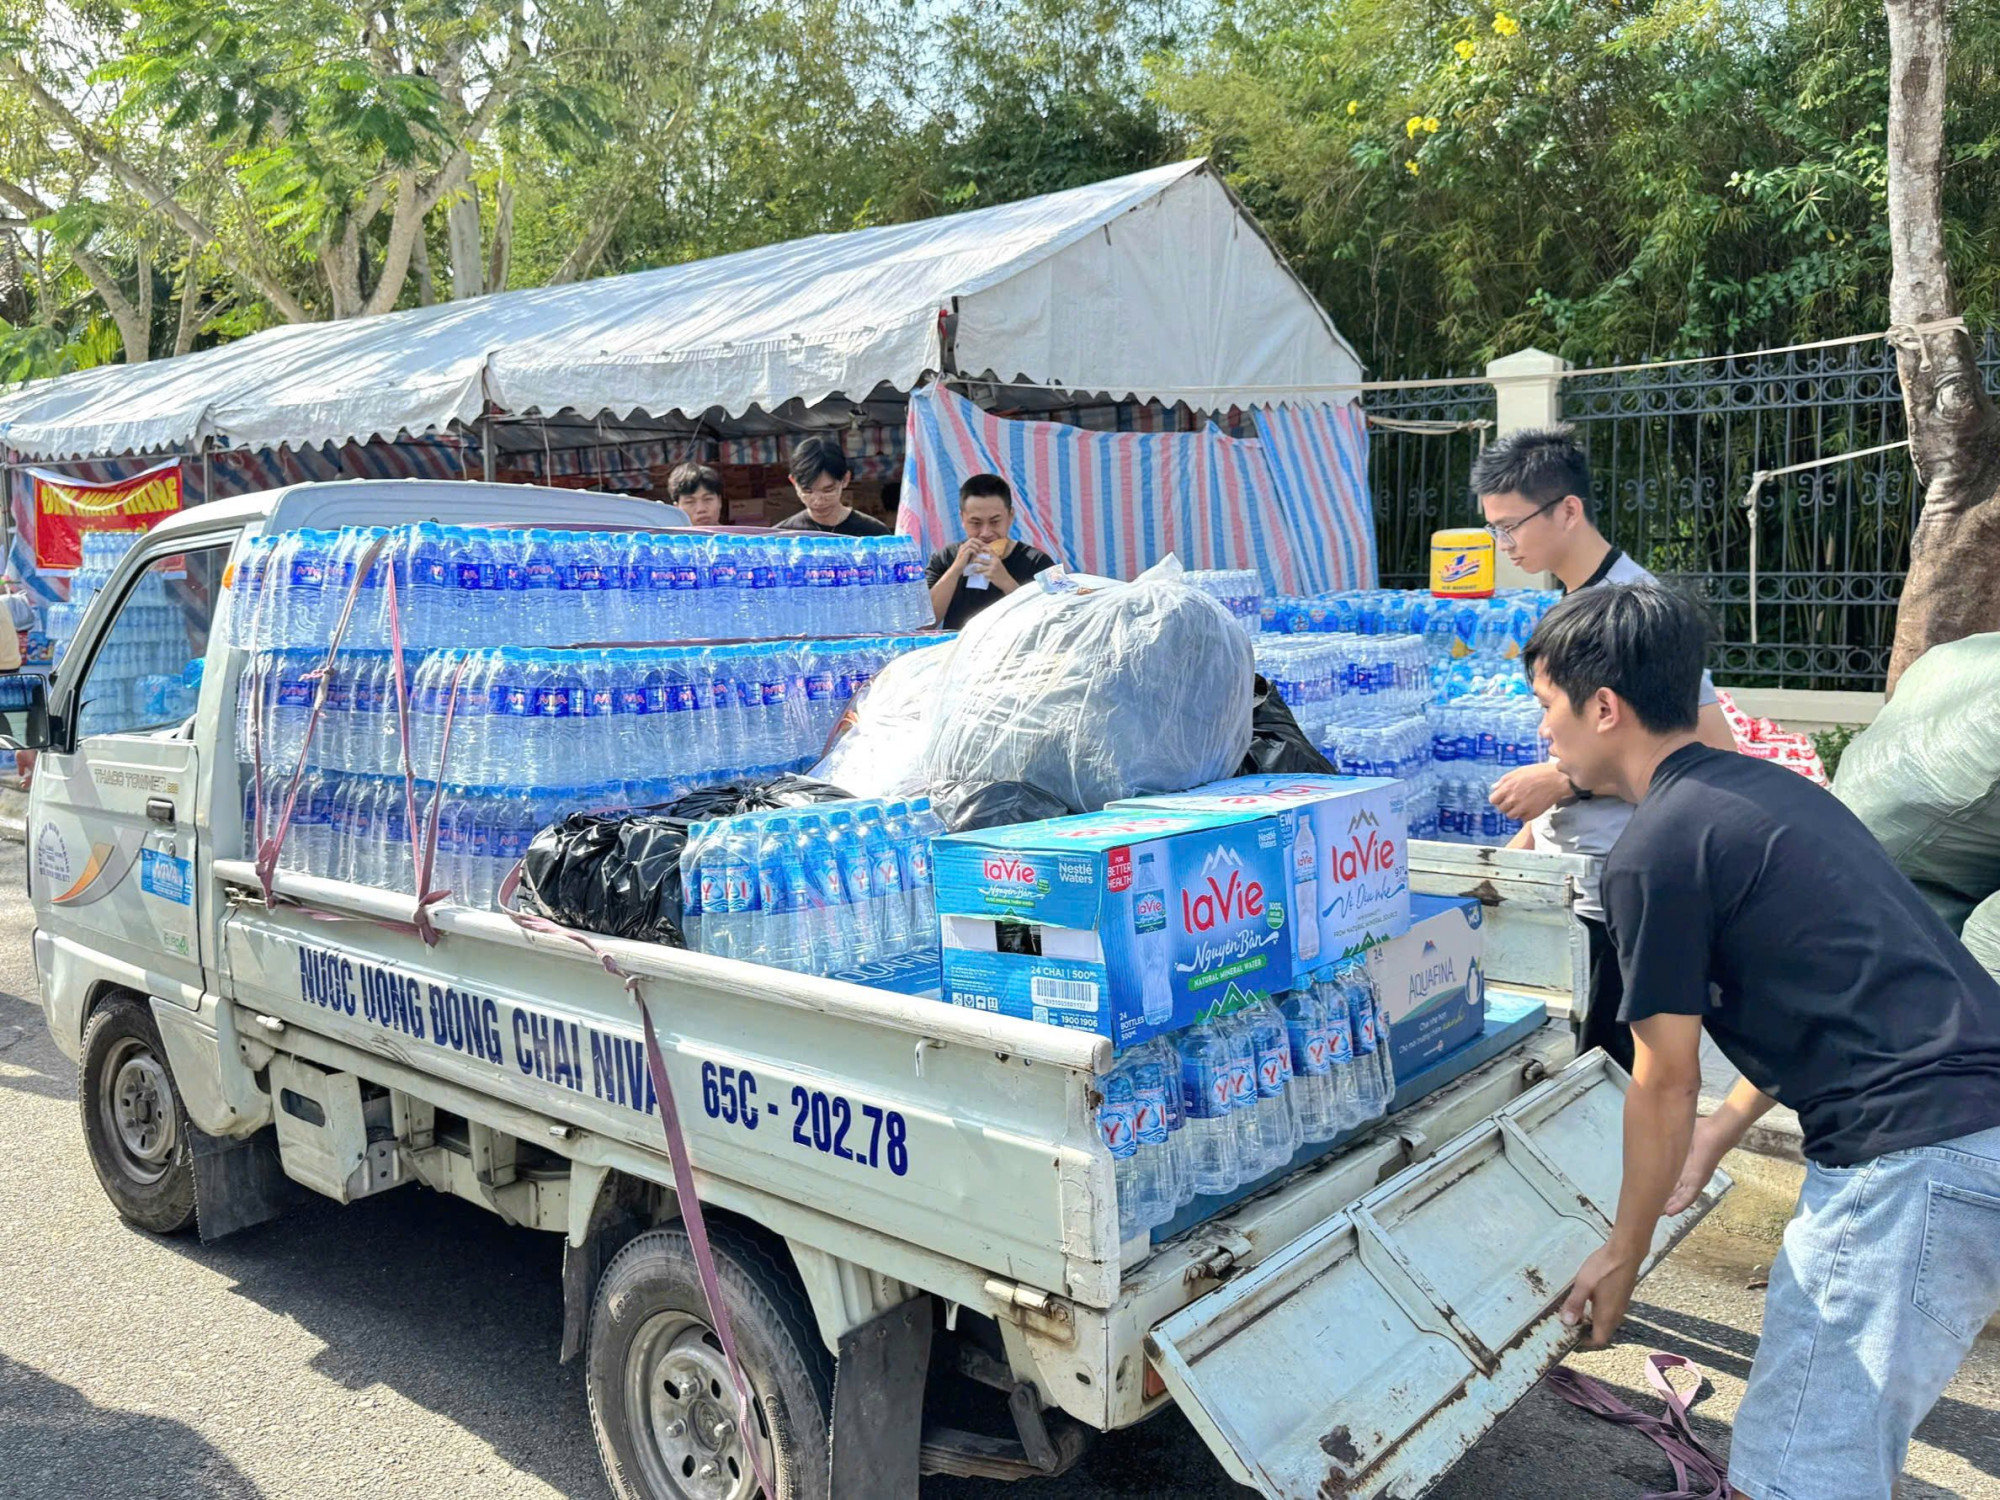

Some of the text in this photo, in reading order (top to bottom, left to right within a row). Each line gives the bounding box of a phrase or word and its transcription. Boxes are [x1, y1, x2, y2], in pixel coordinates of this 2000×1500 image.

[1280, 813, 1293, 827] EW
[1332, 830, 1395, 884] laVie
[984, 858, 1035, 883] laVie
[1059, 862, 1093, 875] Nestlé
[1107, 862, 1132, 877] BETTER
[1059, 873, 1094, 884] Waters
[1107, 875, 1132, 889] HEALTH
[1181, 869, 1264, 935] laVie
[1030, 966, 1042, 975] 24
[1193, 958, 1263, 988] NATURAL MINERAL WATER
[1408, 956, 1457, 1005] AQUAFINA
[1061, 1015, 1080, 1025] 1900
[1080, 1018, 1098, 1028] 1906
[1120, 1016, 1145, 1029] BOTTLES
[512, 1007, 583, 1093] CHAI
[701, 1060, 759, 1130] 65C
[791, 1085, 909, 1177] 202.78
